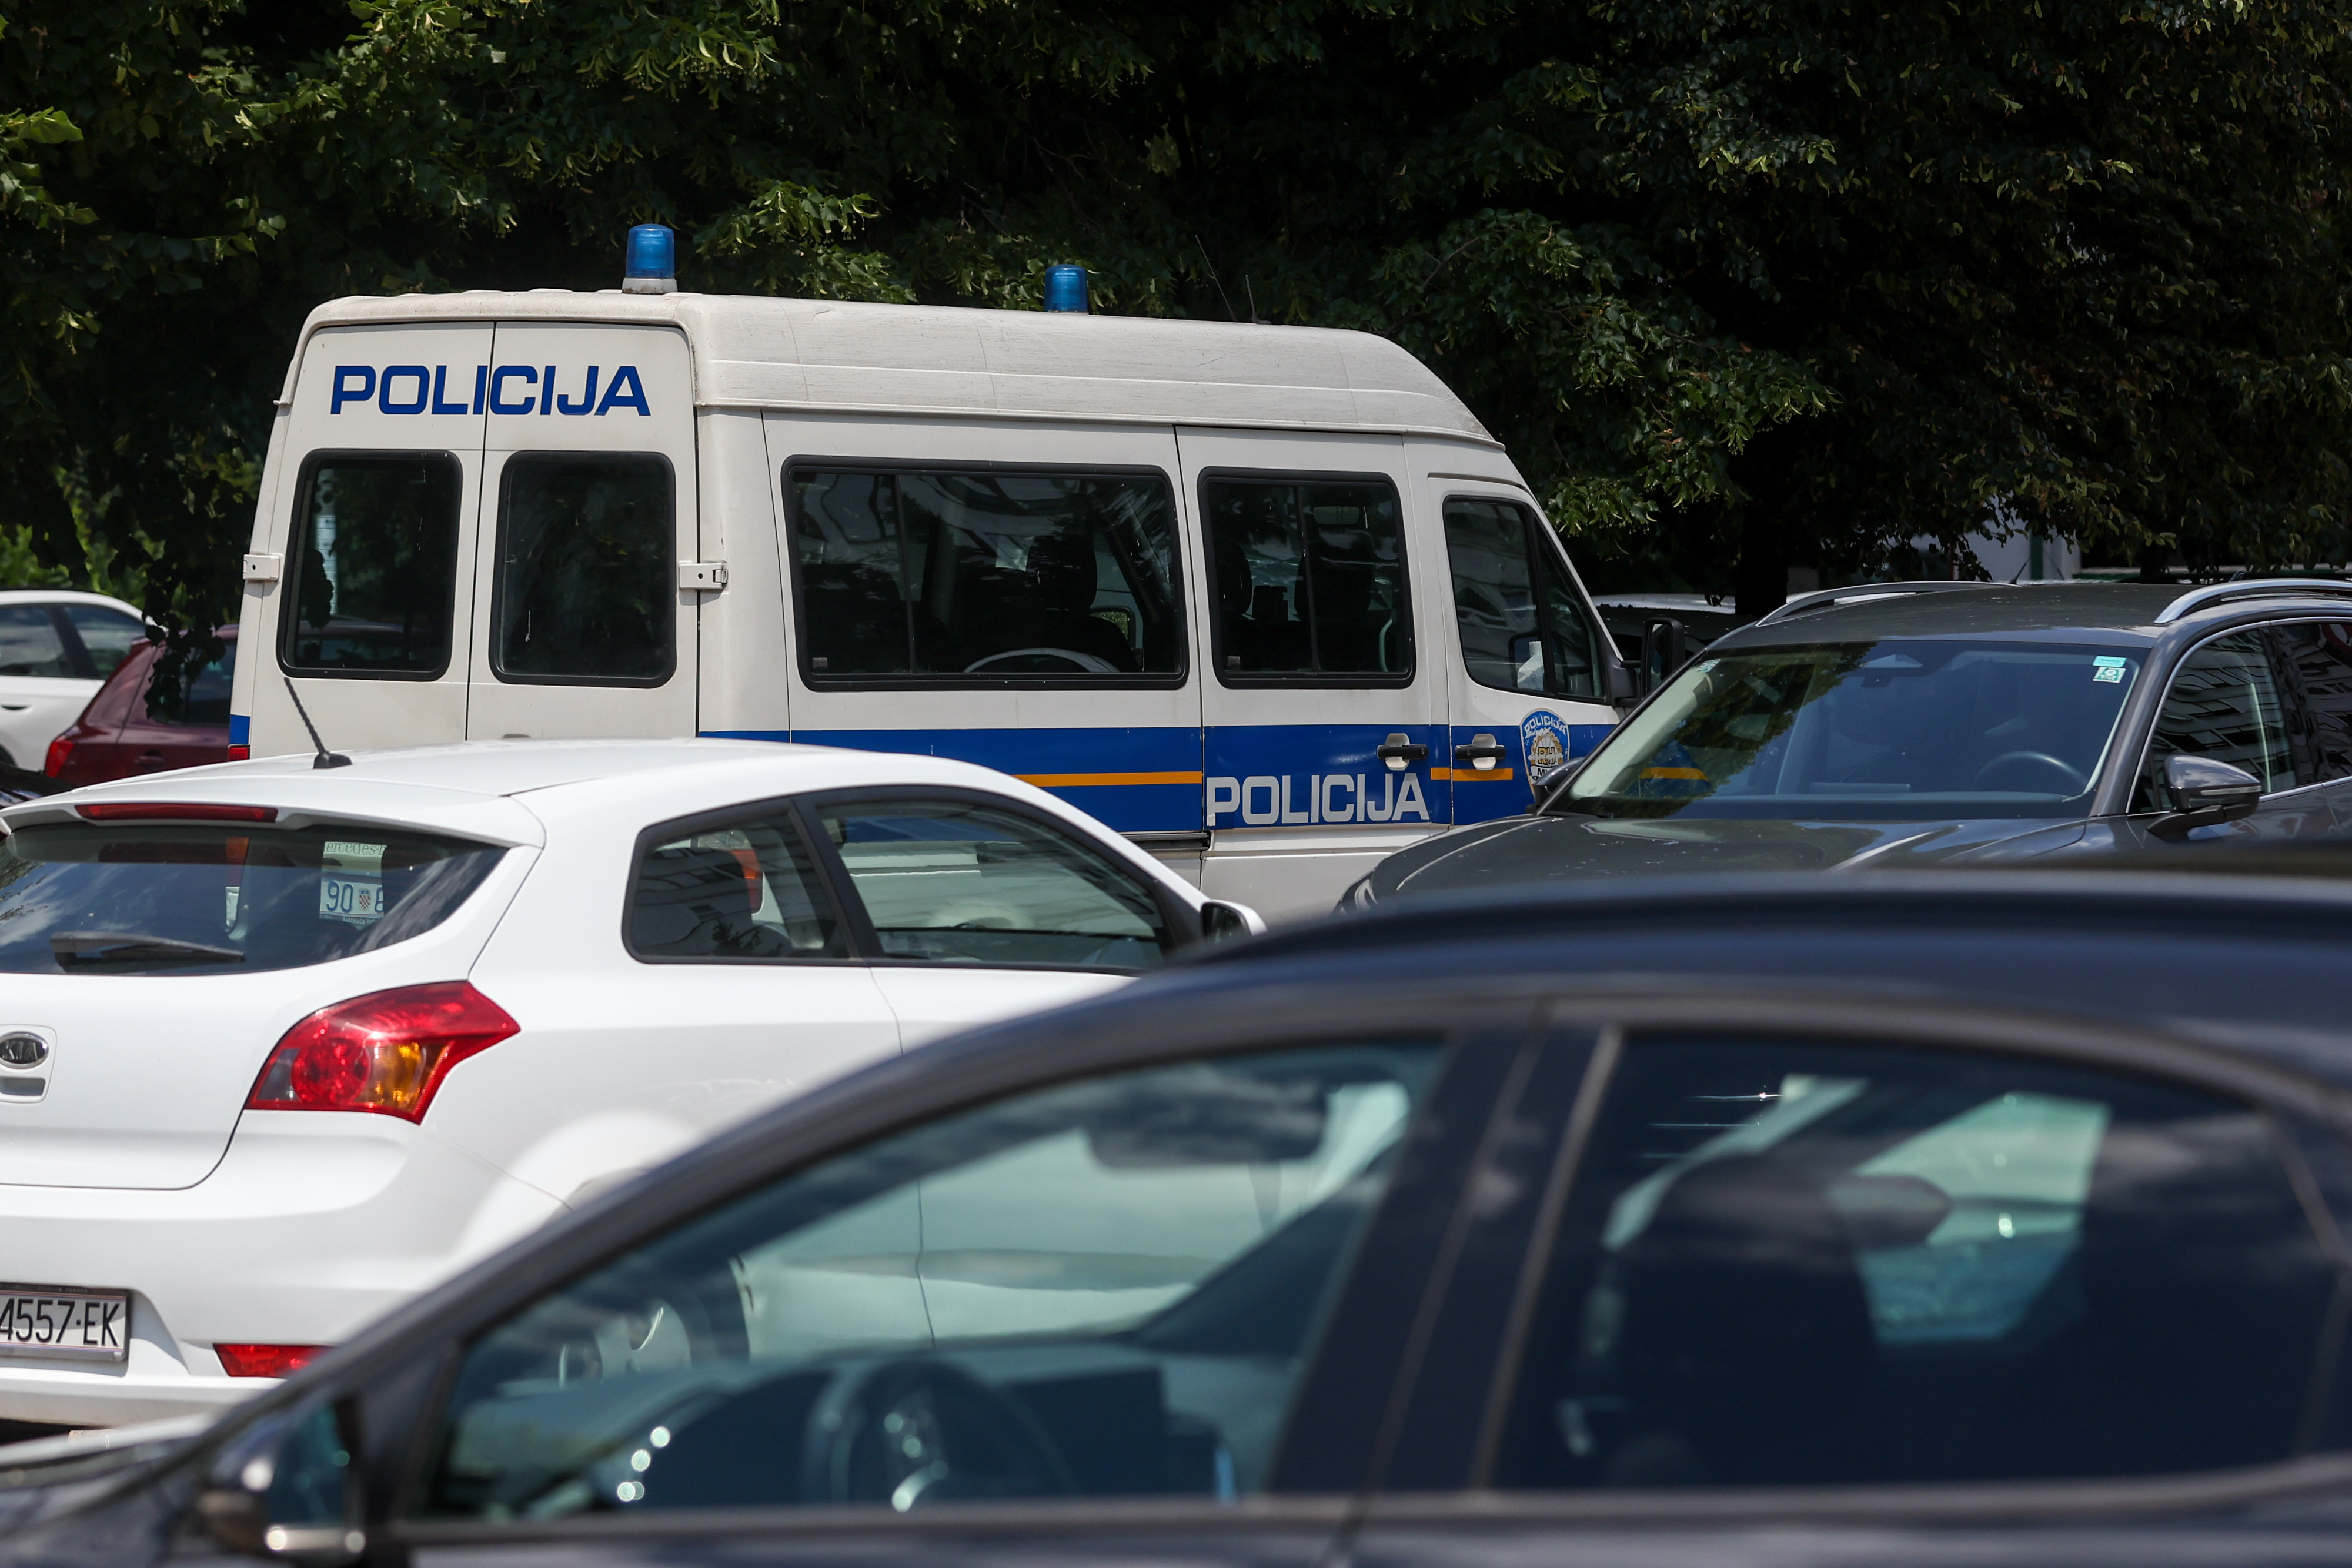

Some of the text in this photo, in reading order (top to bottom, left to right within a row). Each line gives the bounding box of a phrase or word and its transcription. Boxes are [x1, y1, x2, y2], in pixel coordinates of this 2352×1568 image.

[330, 365, 651, 416] POLICIJA
[1524, 716, 1566, 736] POLICIJA
[1206, 773, 1430, 827] POLICIJA
